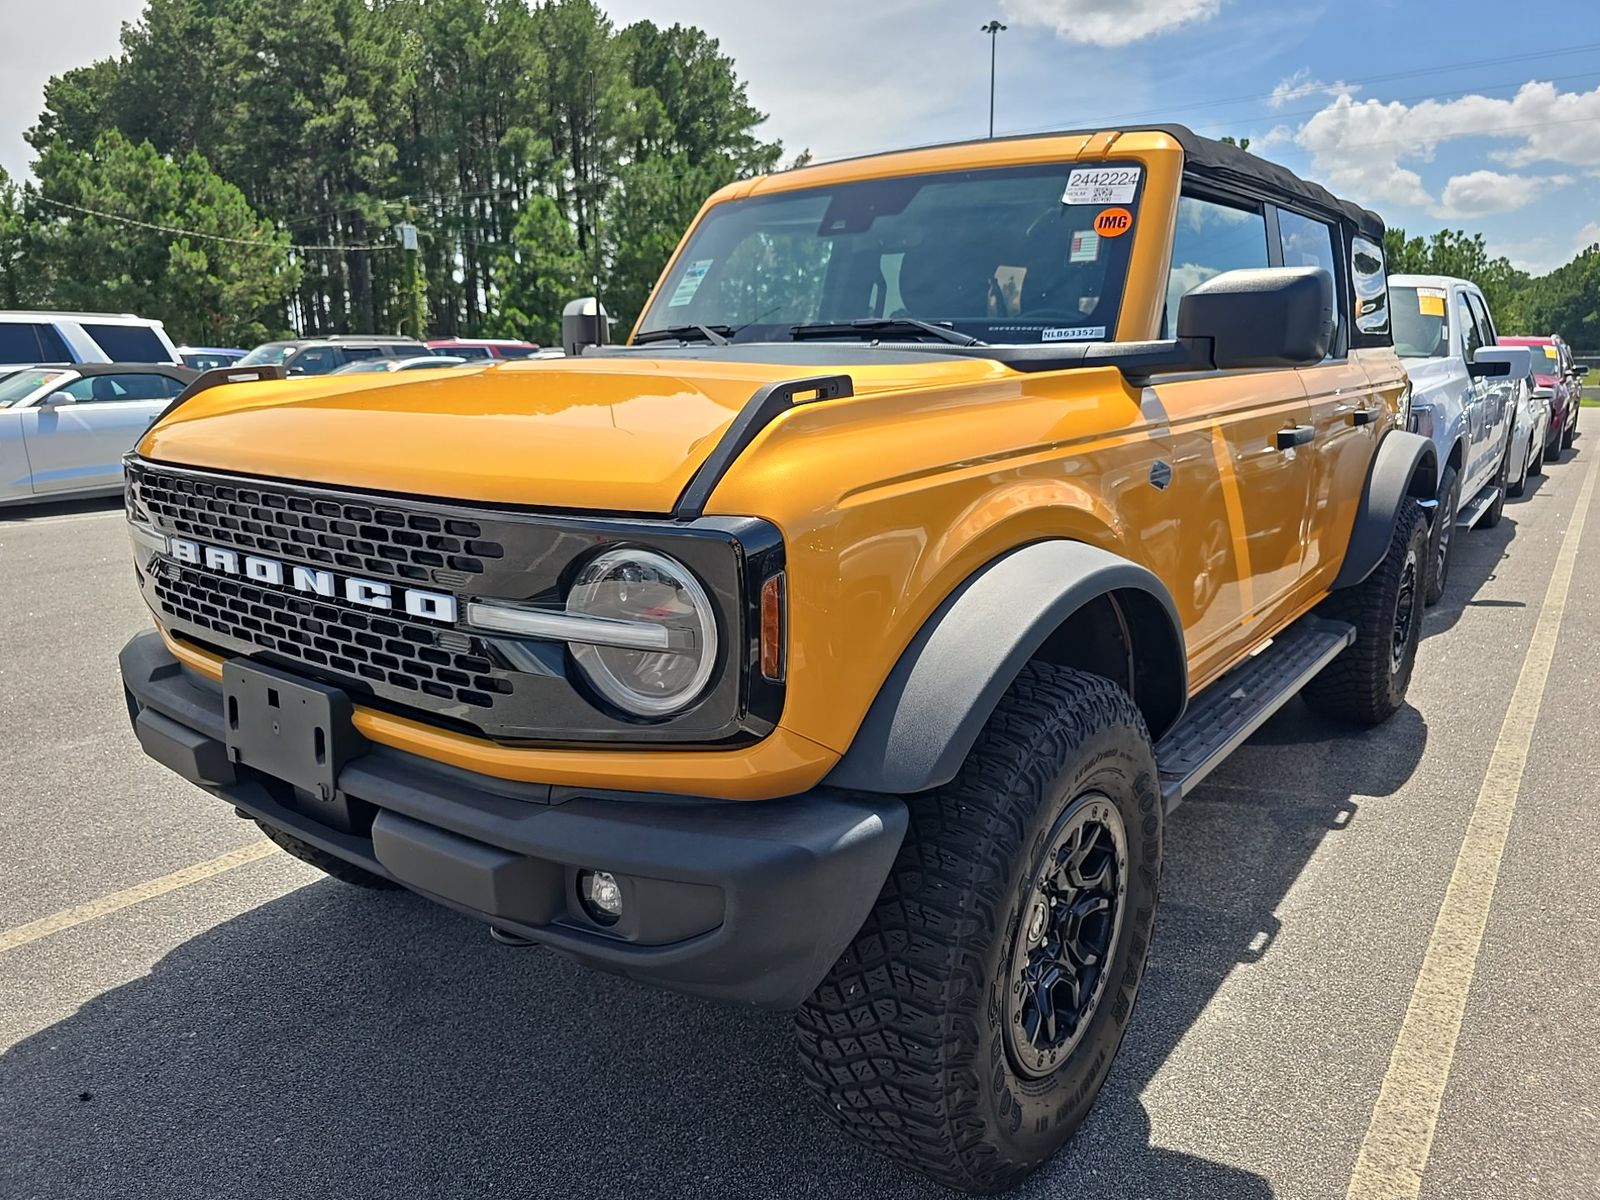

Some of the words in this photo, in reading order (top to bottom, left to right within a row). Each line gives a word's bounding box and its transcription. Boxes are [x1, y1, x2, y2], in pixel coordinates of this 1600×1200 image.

[1071, 172, 1138, 187] 2442224
[1098, 215, 1128, 229] IMG
[170, 537, 458, 623] BRONCO
